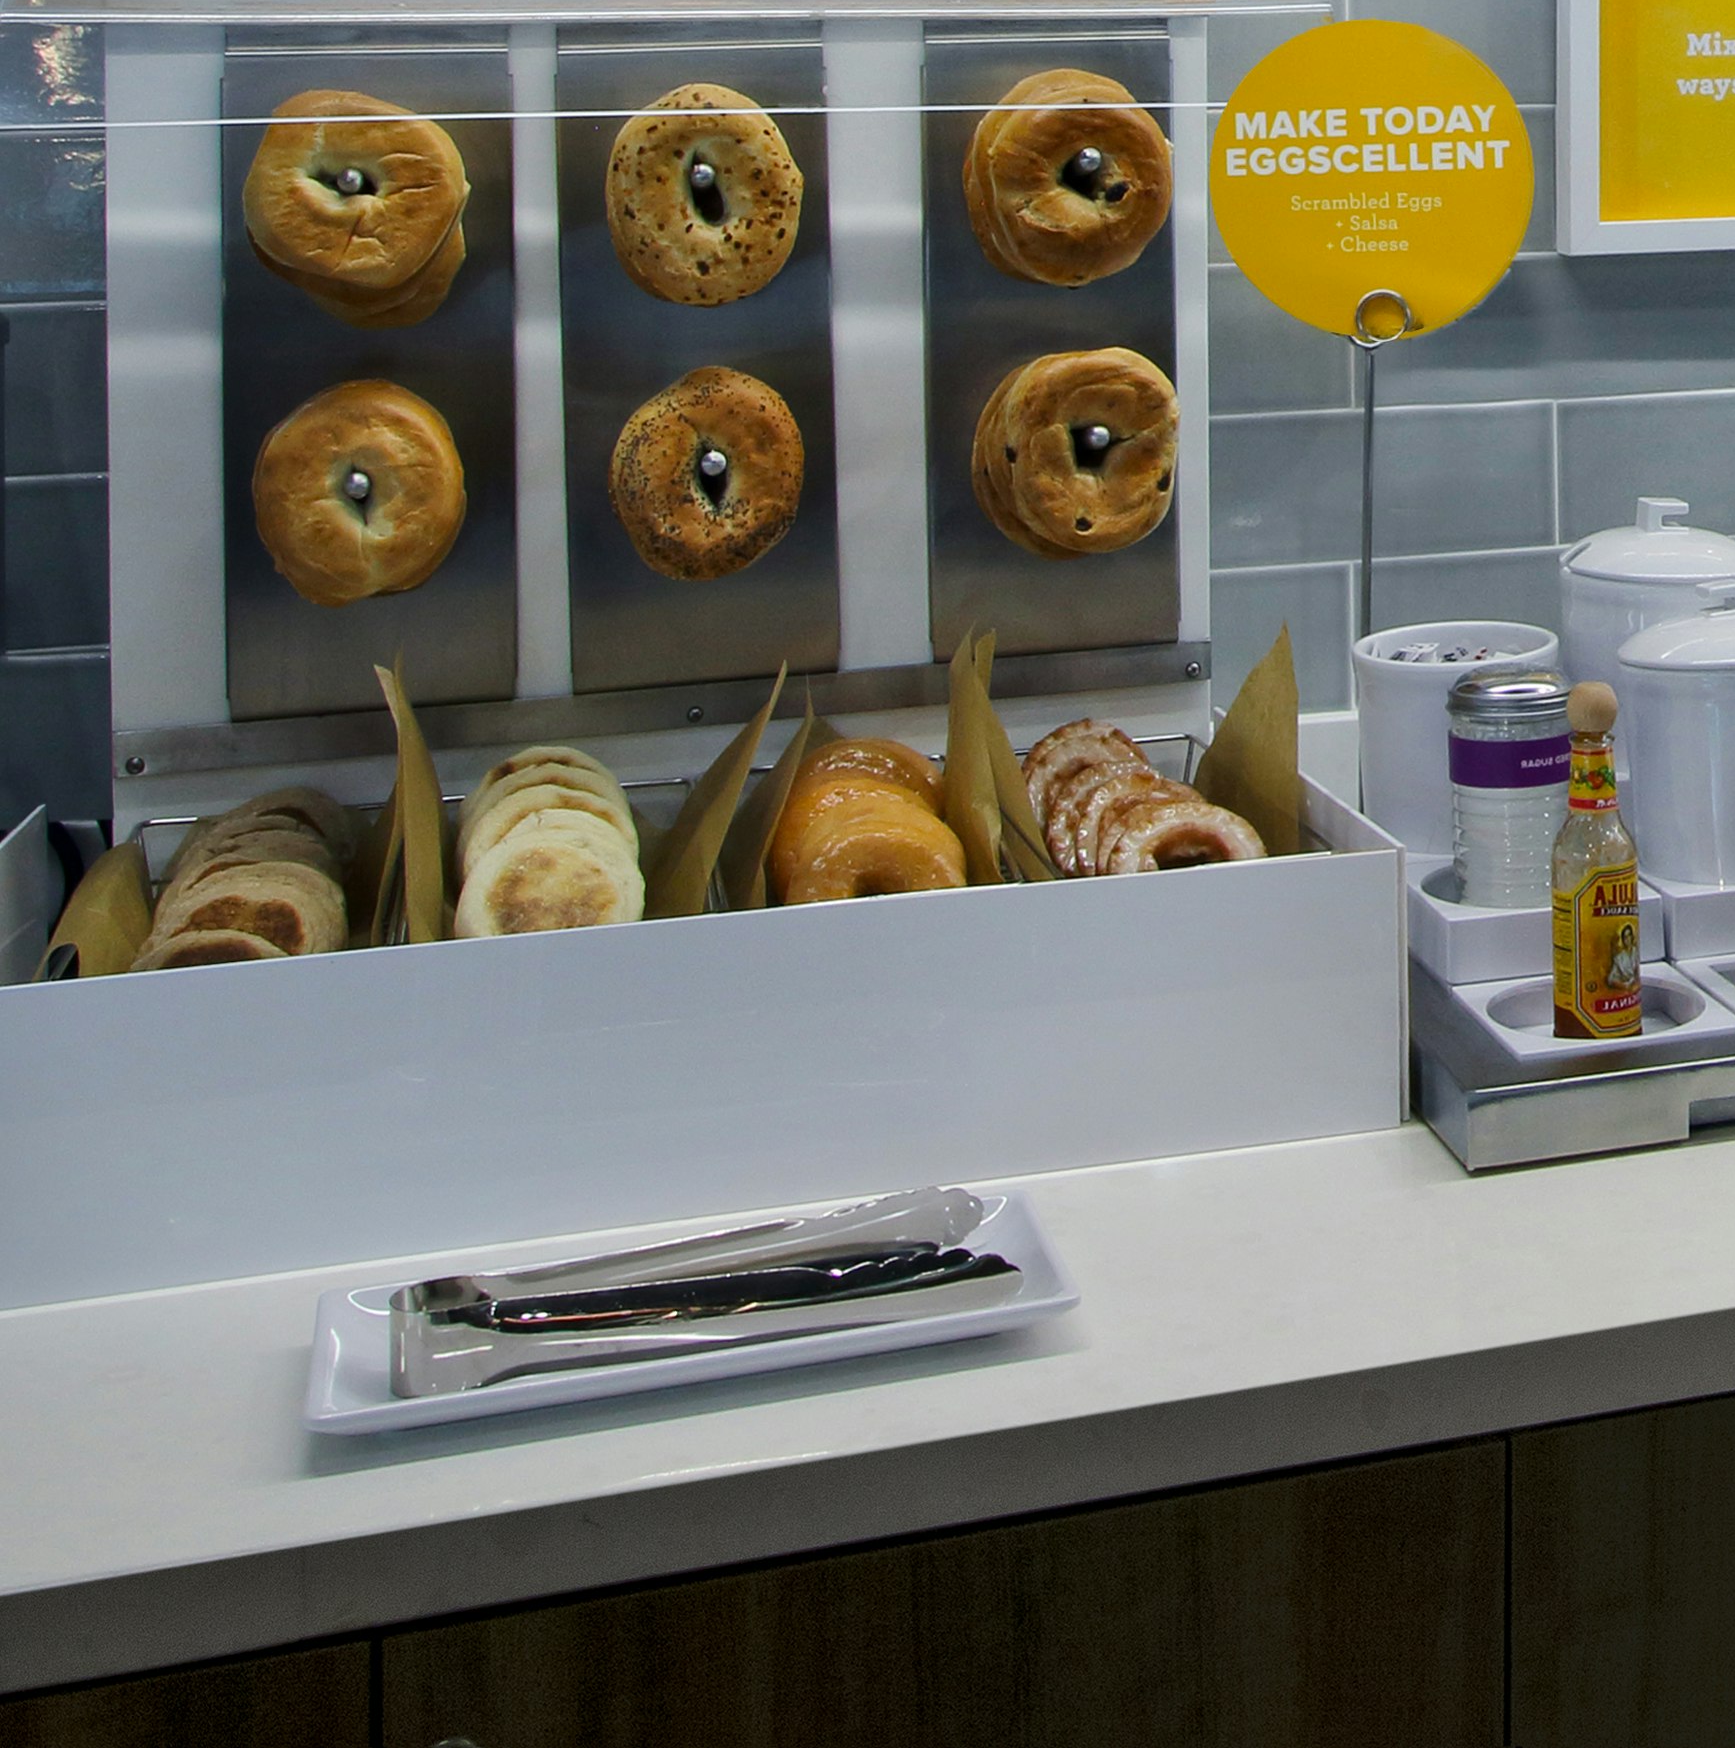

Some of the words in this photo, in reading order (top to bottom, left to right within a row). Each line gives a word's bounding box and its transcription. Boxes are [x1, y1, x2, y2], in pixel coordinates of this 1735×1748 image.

[1235, 108, 1348, 140] MAKE
[1360, 104, 1496, 135] TODAY
[1225, 139, 1510, 176] EGGSCELLENT
[1291, 193, 1389, 211] Scrambled
[1397, 193, 1442, 212] Eggs
[1350, 215, 1398, 230] Salsa
[1340, 237, 1409, 252] Cheese
